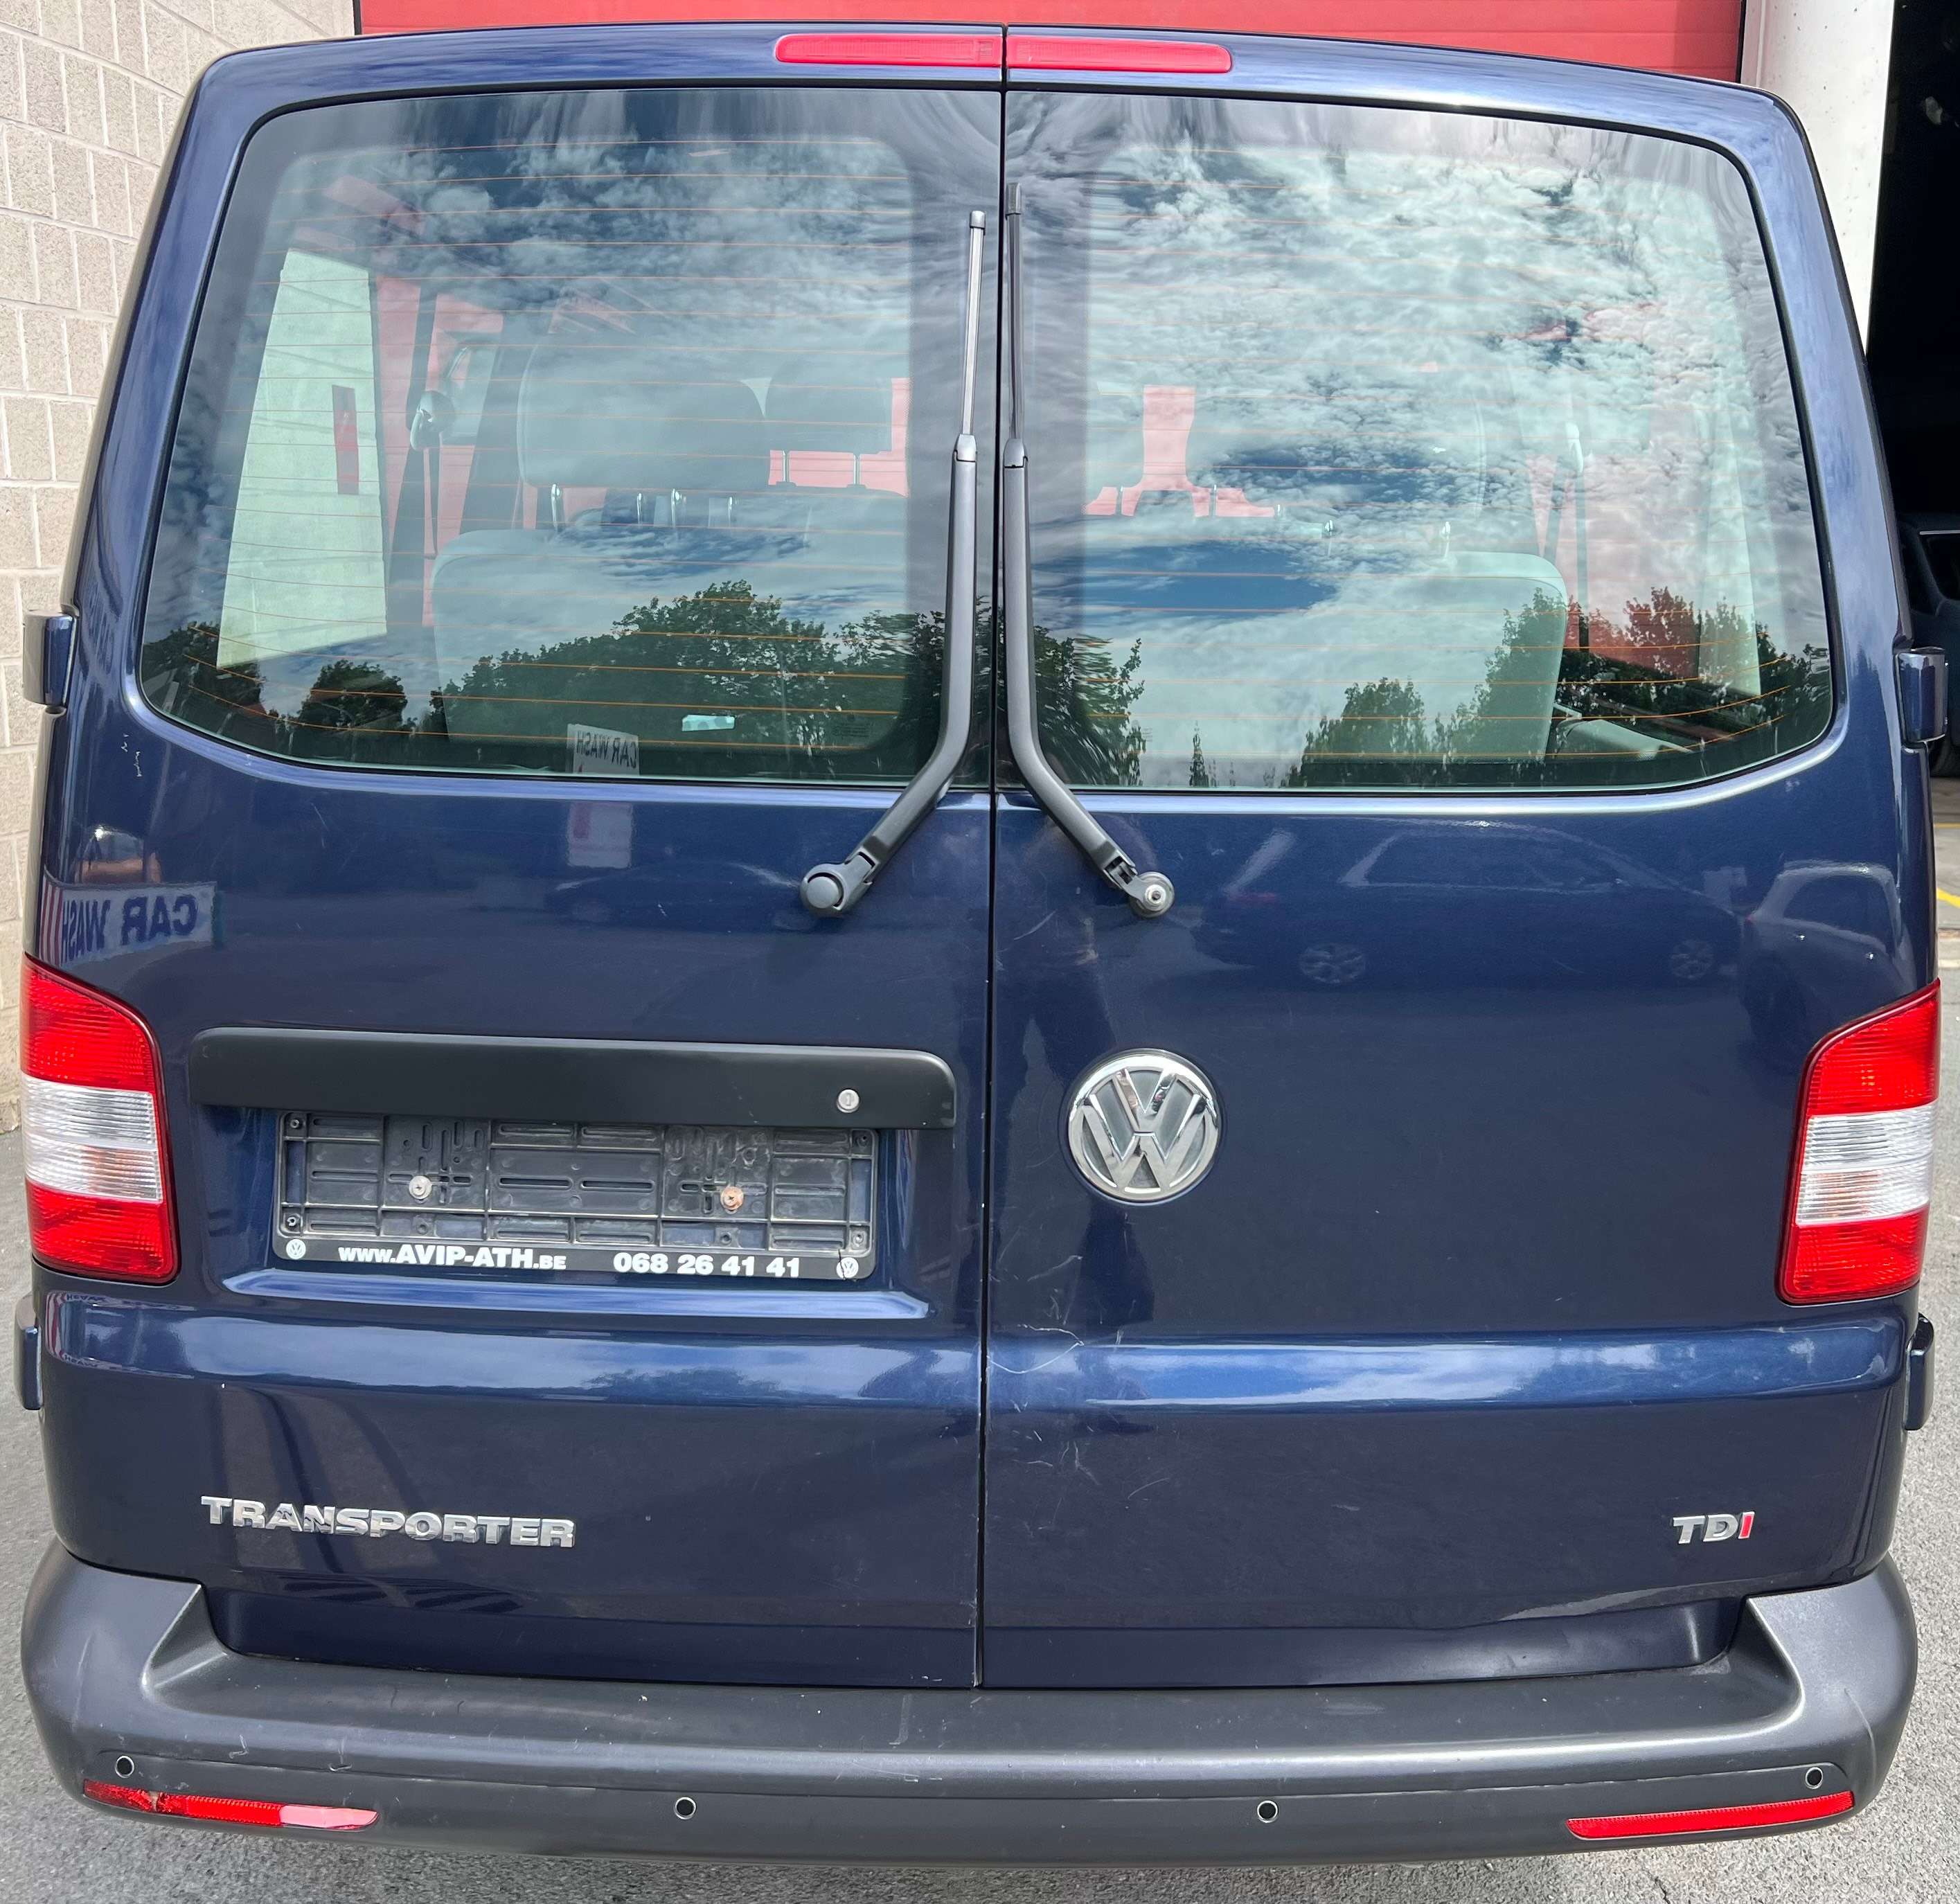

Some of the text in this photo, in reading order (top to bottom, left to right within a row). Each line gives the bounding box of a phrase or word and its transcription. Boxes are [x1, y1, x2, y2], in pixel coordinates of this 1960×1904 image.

[1069, 1050, 1219, 1203] VW
[338, 1244, 567, 1270] www.AVIP-ATH.BE
[613, 1252, 799, 1278] 068 26 41 41
[201, 1495, 576, 1548] TRANSPORTER
[1673, 1511, 1755, 1545] TDI
